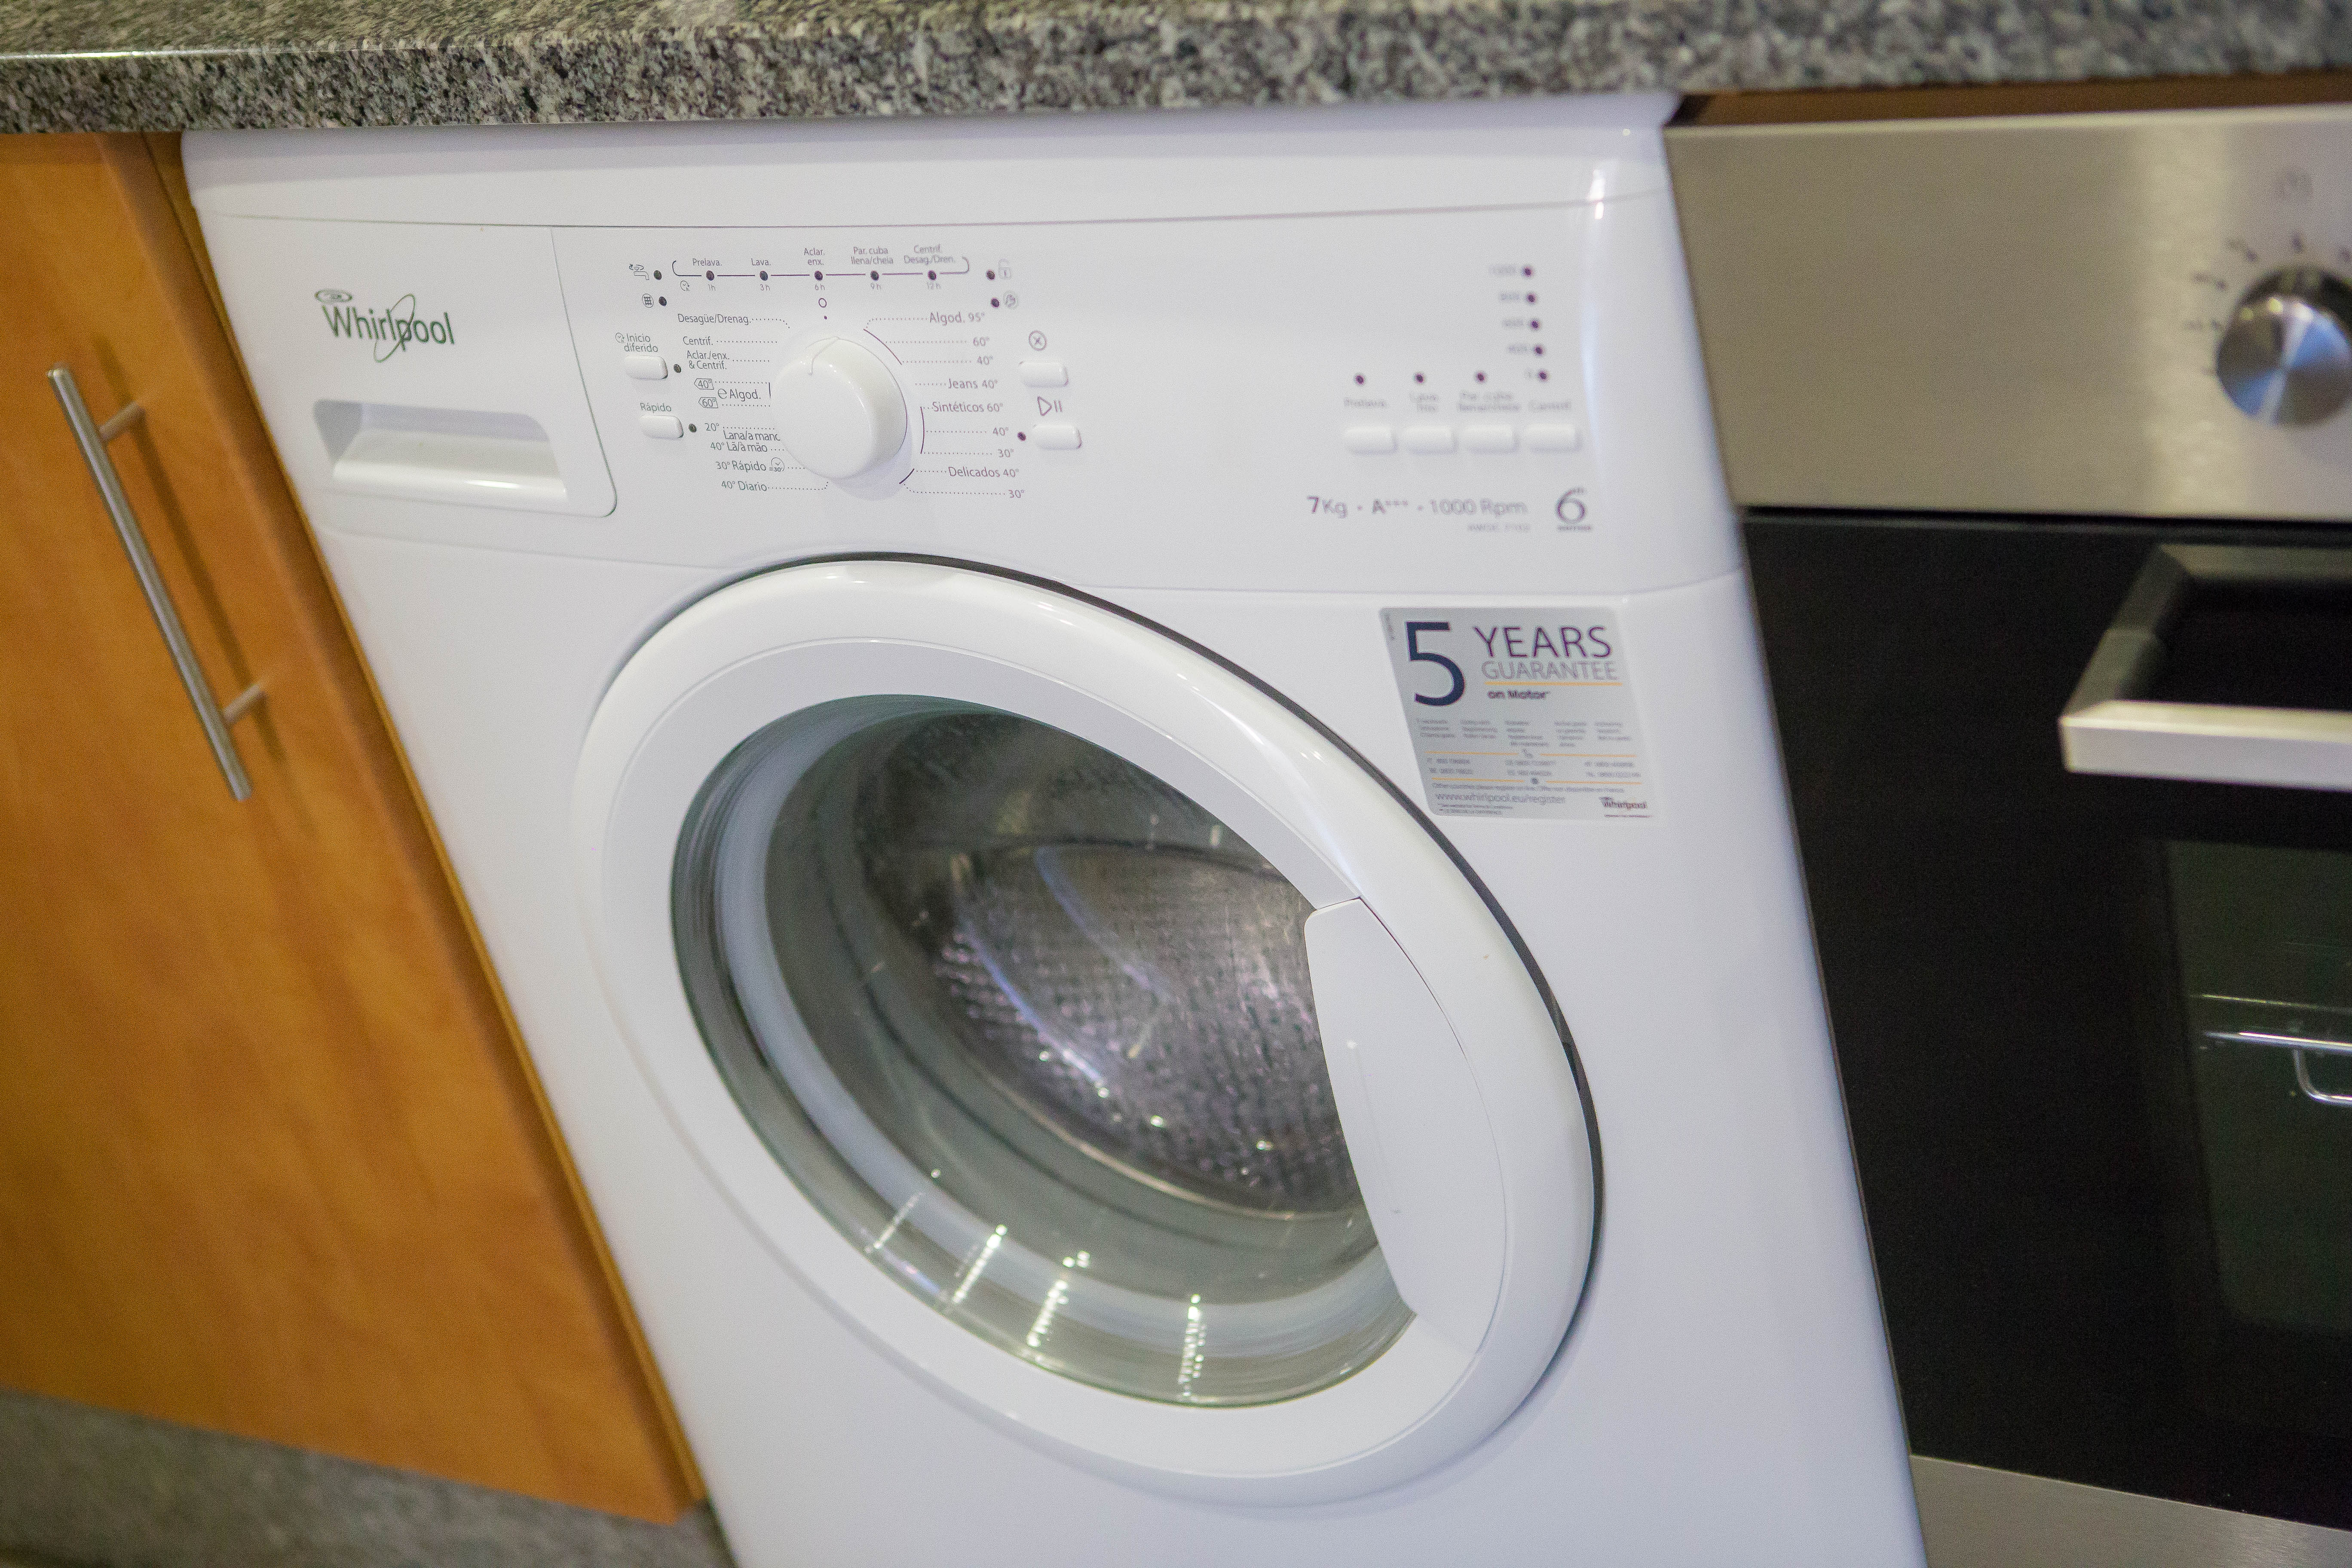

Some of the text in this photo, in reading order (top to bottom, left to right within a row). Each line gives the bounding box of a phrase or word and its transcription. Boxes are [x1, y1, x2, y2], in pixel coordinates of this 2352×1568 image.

[804, 247, 825, 256] Aclar.
[869, 246, 888, 255] cuba
[692, 258, 722, 266] Prelava.
[677, 313, 751, 325] Desagüe/Drenag.
[929, 312, 965, 326] Algod.
[322, 306, 455, 352] Whirlpool
[683, 336, 714, 346] Centrif.
[624, 343, 658, 352] diferido
[686, 350, 730, 360] Aclar./enx.
[689, 360, 727, 370] & Centrif.
[697, 380, 711, 389] 40°
[948, 378, 978, 389] Jeans
[729, 389, 761, 401] Algod.
[640, 402, 672, 413] Rápido
[702, 398, 716, 407] 60°
[932, 401, 984, 413] Sintéticos
[705, 423, 720, 432] 20°
[723, 430, 753, 441] Lana/a
[710, 442, 725, 451] 40°
[747, 442, 768, 452] mão
[715, 461, 730, 470] 30°
[732, 460, 767, 473] Rápido
[948, 466, 1000, 478] Delicados
[721, 481, 767, 491] 40° Diario
[1473, 627, 1613, 658] YEARS
[1406, 621, 1466, 706] 5
[1481, 660, 1620, 681] GUARANTEE
